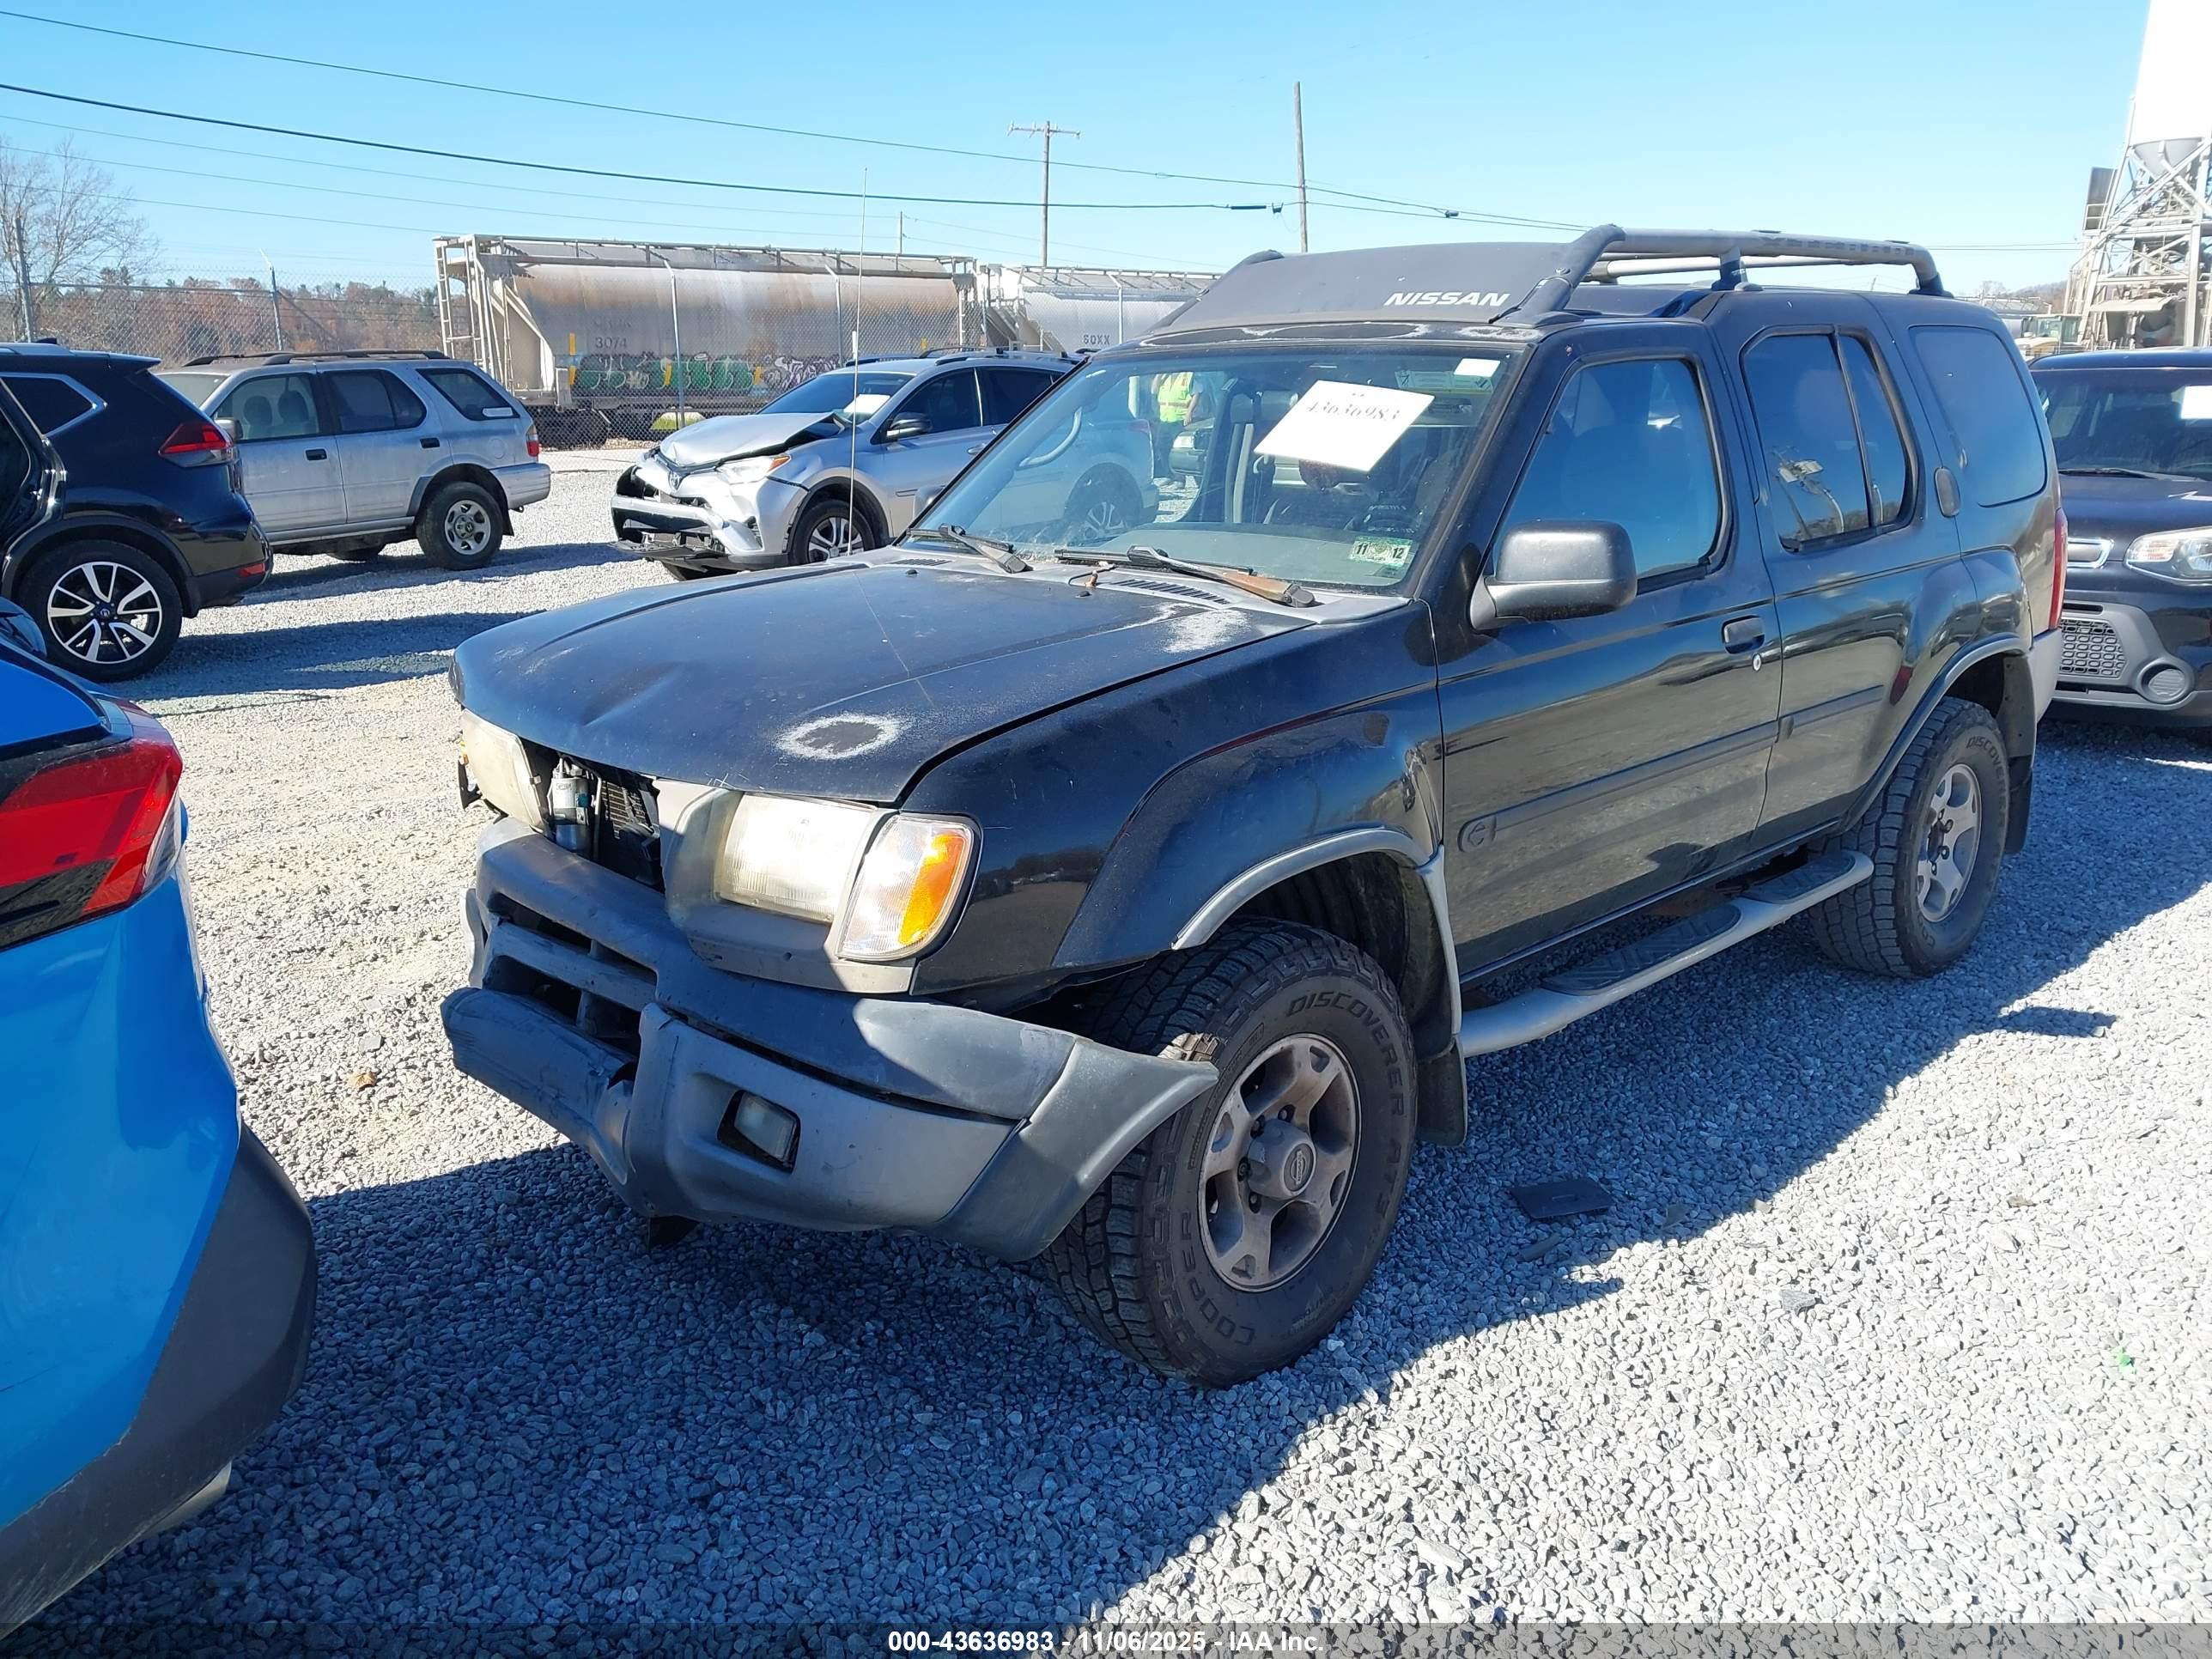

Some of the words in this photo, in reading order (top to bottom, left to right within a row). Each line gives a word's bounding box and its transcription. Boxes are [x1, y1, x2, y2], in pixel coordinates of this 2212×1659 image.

[1382, 291, 1511, 307] NISSAN
[595, 336, 628, 349] 3074
[1356, 542, 1369, 555] 11
[1392, 547, 1405, 559] 12
[1286, 990, 1405, 1116] DISCOVERER
[1181, 1211, 1256, 1346] COOPER
